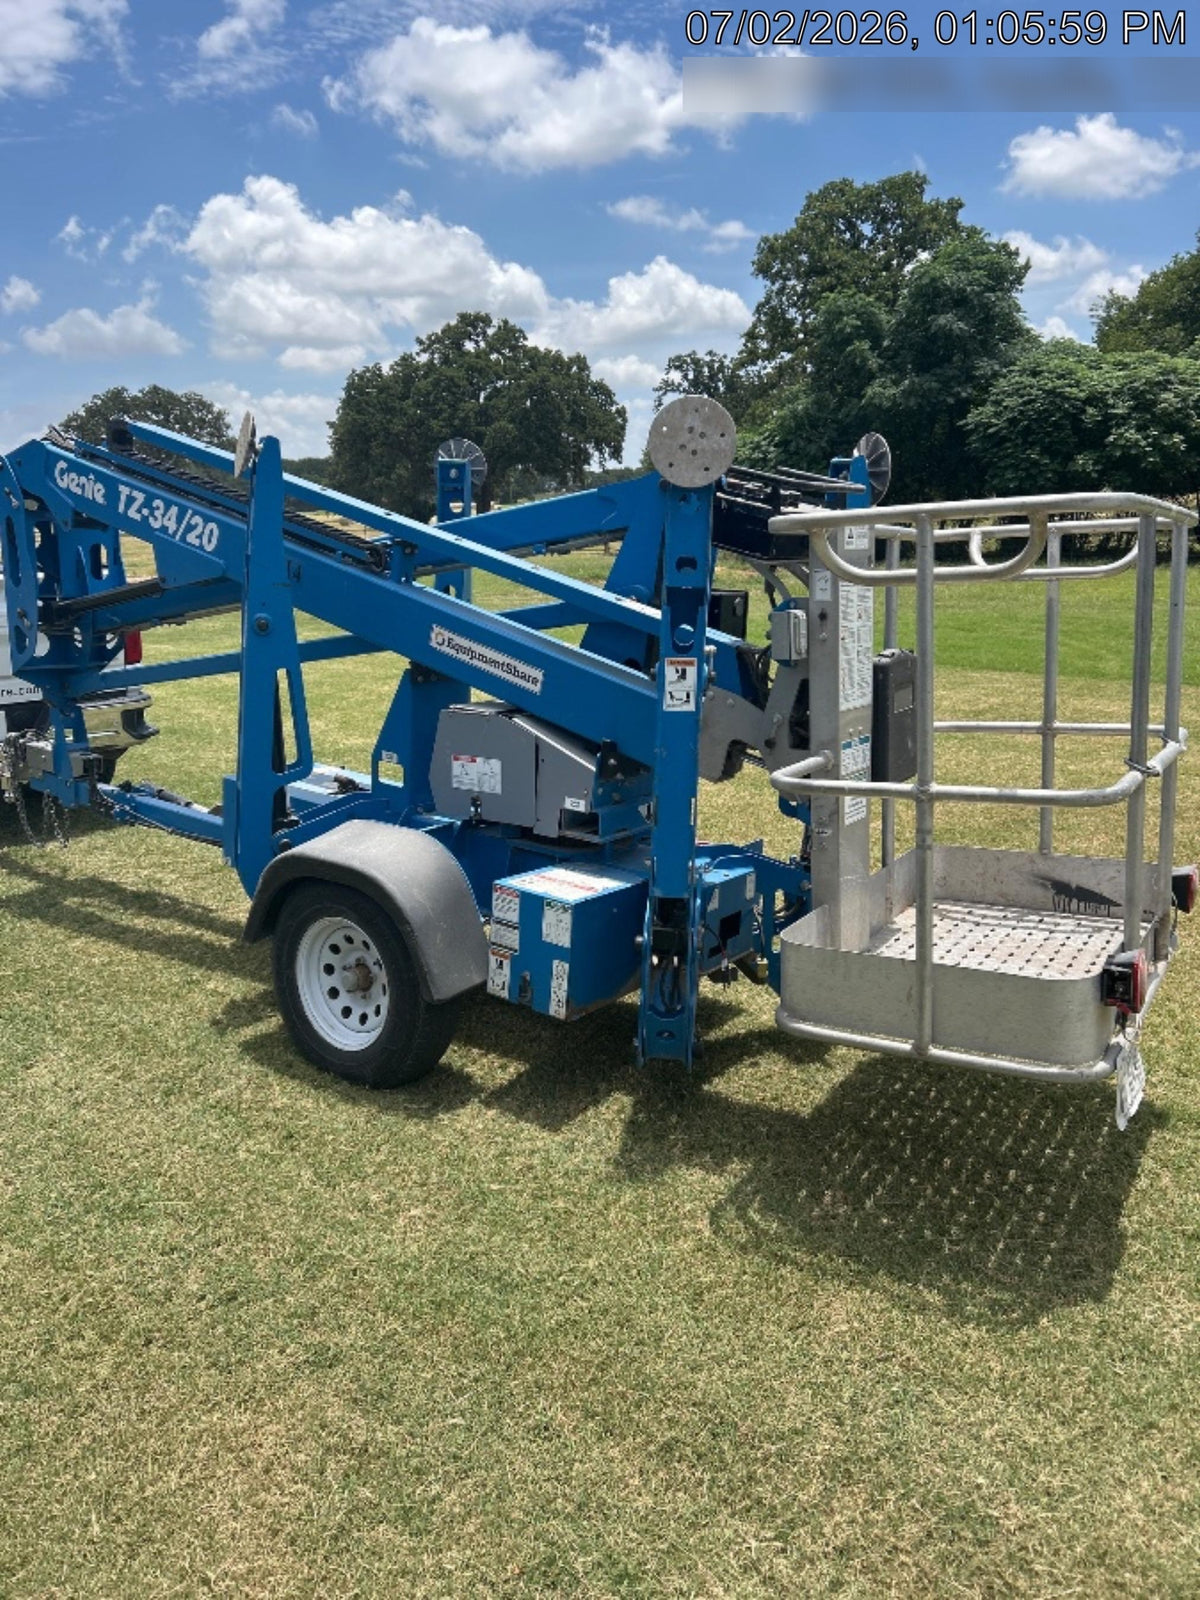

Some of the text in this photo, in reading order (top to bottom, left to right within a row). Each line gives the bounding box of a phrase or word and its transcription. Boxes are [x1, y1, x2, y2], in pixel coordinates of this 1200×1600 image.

[54, 460, 219, 552] Genie TZ-34/20
[446, 637, 540, 687] EquipmentShare
